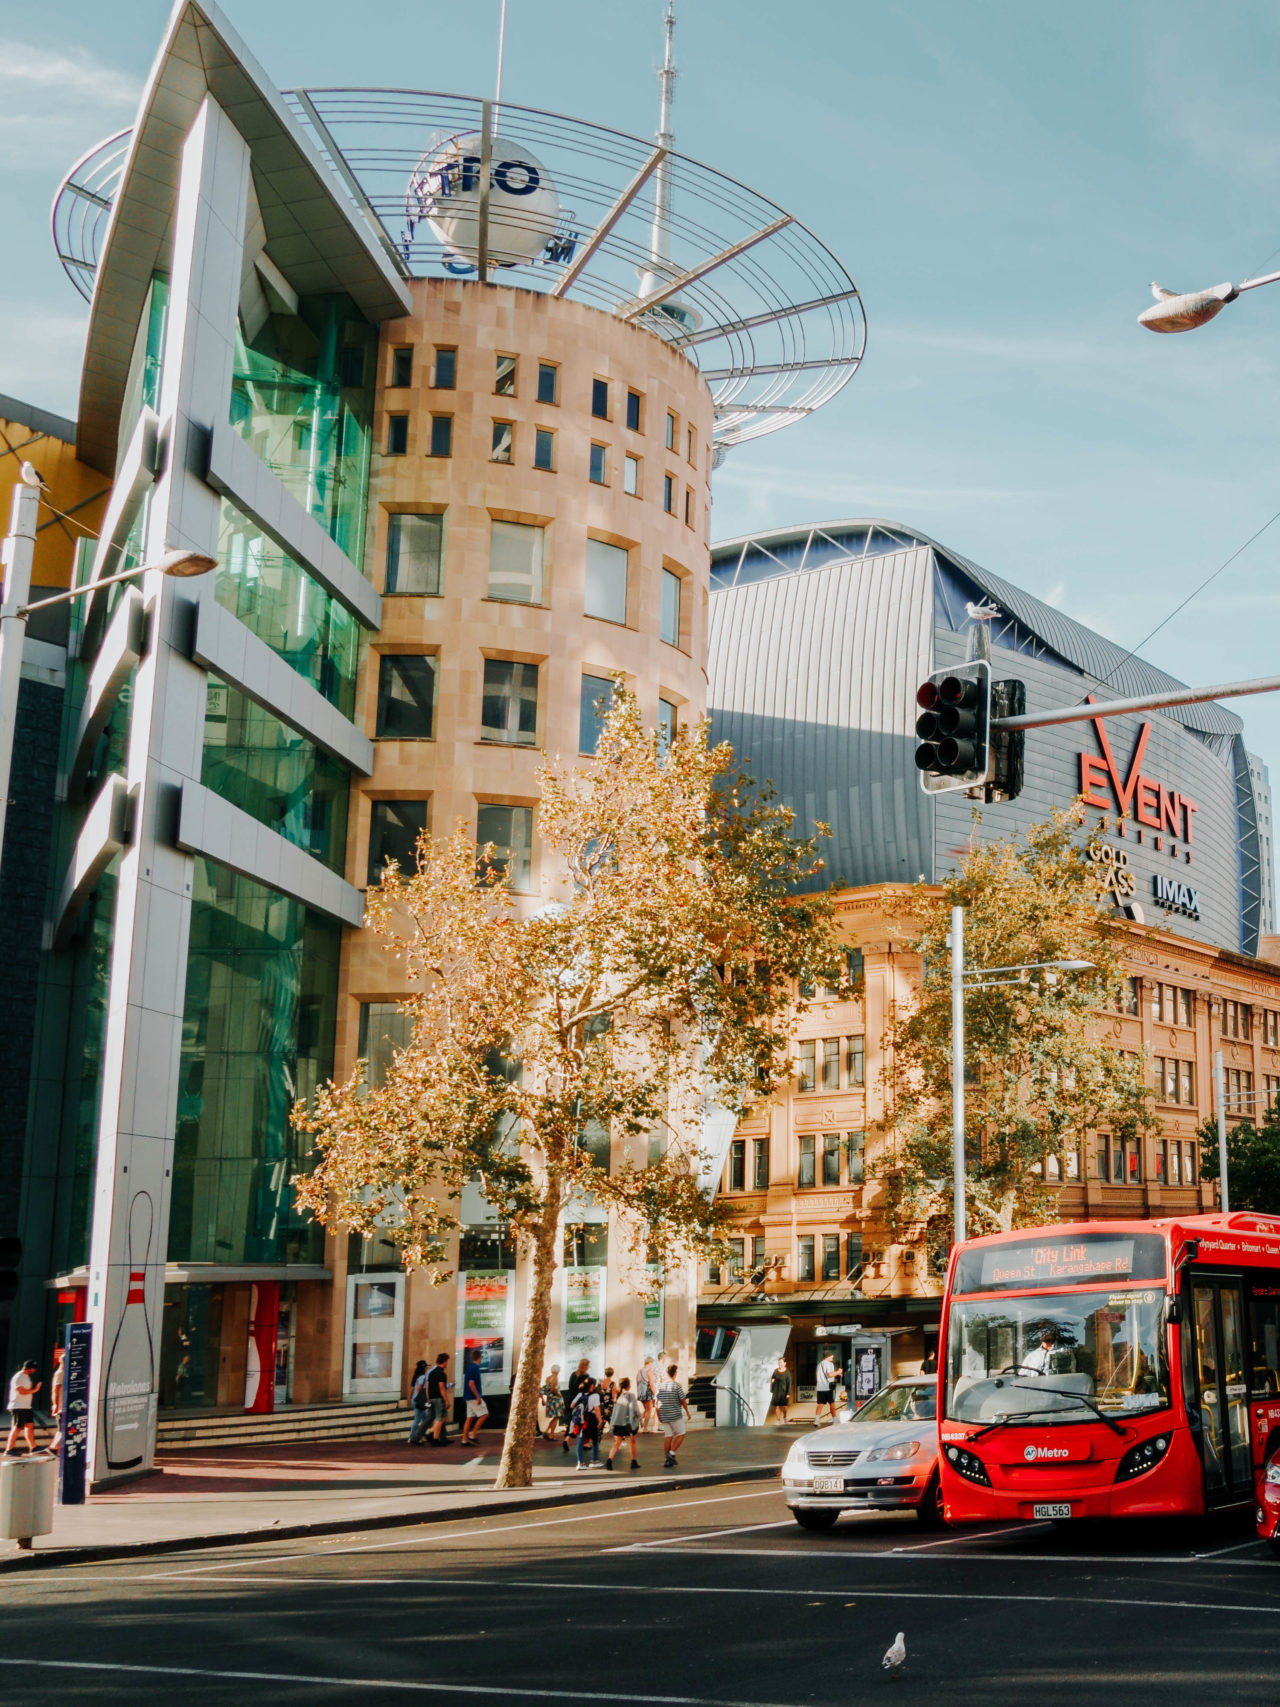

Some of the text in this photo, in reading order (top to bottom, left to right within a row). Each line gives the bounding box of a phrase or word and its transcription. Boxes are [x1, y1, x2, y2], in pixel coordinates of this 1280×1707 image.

[1079, 695, 1199, 844] EVENT
[1089, 842, 1129, 869] GOLD
[1153, 874, 1200, 913] IMAX
[1034, 1245, 1087, 1265] City Link
[993, 1256, 1129, 1281] Queen St Karangahape Rd
[1037, 1447, 1069, 1458] Metro
[1035, 1506, 1070, 1517] HGL563
